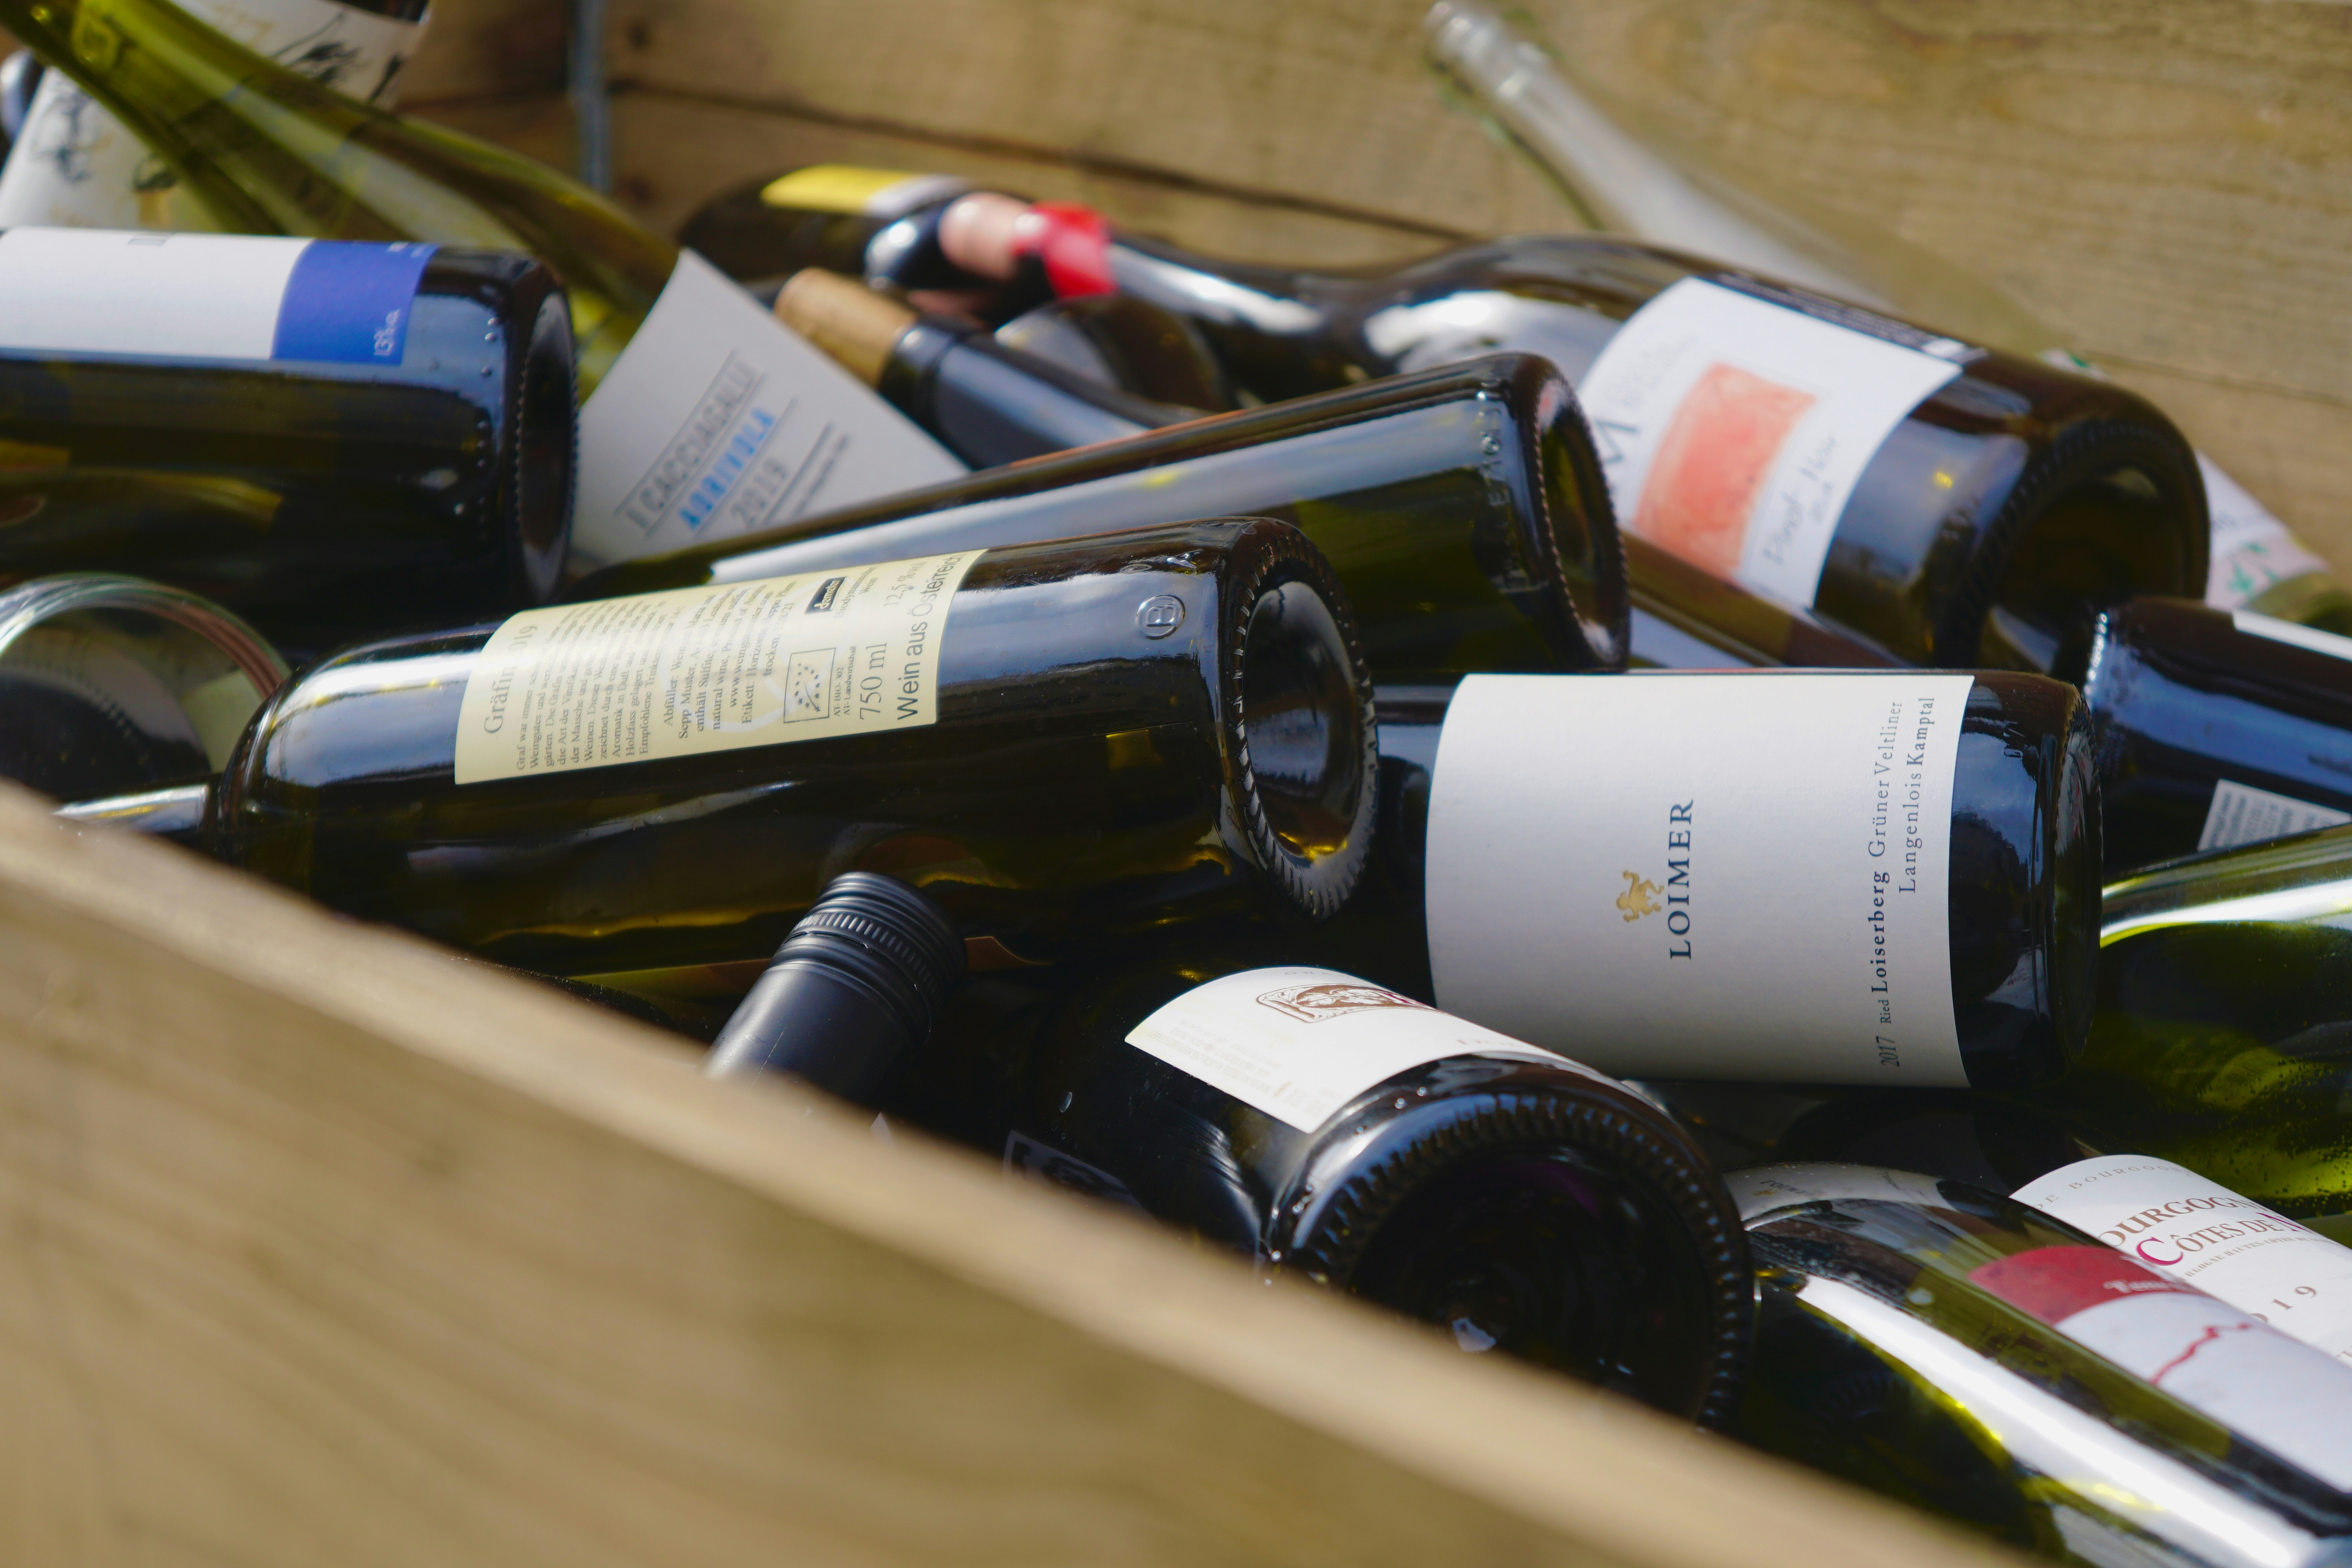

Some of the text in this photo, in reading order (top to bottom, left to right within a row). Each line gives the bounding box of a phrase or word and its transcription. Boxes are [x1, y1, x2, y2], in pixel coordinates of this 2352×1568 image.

[814, 579, 839, 610] demeter
[859, 575, 878, 594] Wein
[883, 584, 906, 606] 12,5
[897, 554, 965, 719] Wein aus Österreich
[608, 663, 619, 682] eine
[622, 652, 635, 668] und
[699, 650, 715, 686] Sulfite,
[716, 655, 730, 684] wine,
[842, 645, 857, 699] Landwirtschaft
[548, 676, 562, 706] Gräfin
[577, 679, 587, 696] und
[617, 670, 629, 692] Duft
[628, 669, 645, 707] gelagert
[681, 662, 697, 704] Muster,
[860, 642, 887, 719] 750 ml
[484, 666, 516, 732] Gräfin
[521, 689, 533, 719] immer
[535, 692, 545, 710] und
[586, 683, 600, 715] Dieser
[601, 684, 613, 712] durch
[614, 694, 624, 704] in
[662, 673, 678, 725] Abfüller:
[694, 690, 706, 731] enthält
[711, 687, 722, 730] natural
[742, 680, 754, 724] Etikett:
[545, 708, 555, 727] Die
[559, 708, 568, 724] der
[570, 699, 583, 742] Maische
[637, 691, 653, 755] Empfohlene
[679, 709, 691, 738] Sepp
[519, 723, 527, 742] war
[528, 714, 543, 768] Weingutes
[557, 727, 567, 745] Art
[596, 715, 610, 760] zeichnet
[610, 707, 624, 759] Aromatik
[623, 710, 637, 757] Holzfass
[516, 746, 526, 770] Graf
[556, 748, 566, 764] die
[570, 746, 580, 763] der
[1898, 697, 1935, 894] Langenlois Kamptal
[1668, 799, 1694, 960] LOIMER
[1868, 702, 1904, 1068] 2017 Ried Loiserberg Grüner Veltliner
[2136, 1223, 2245, 1266] CÔTES
[2236, 1220, 2284, 1232] DE
